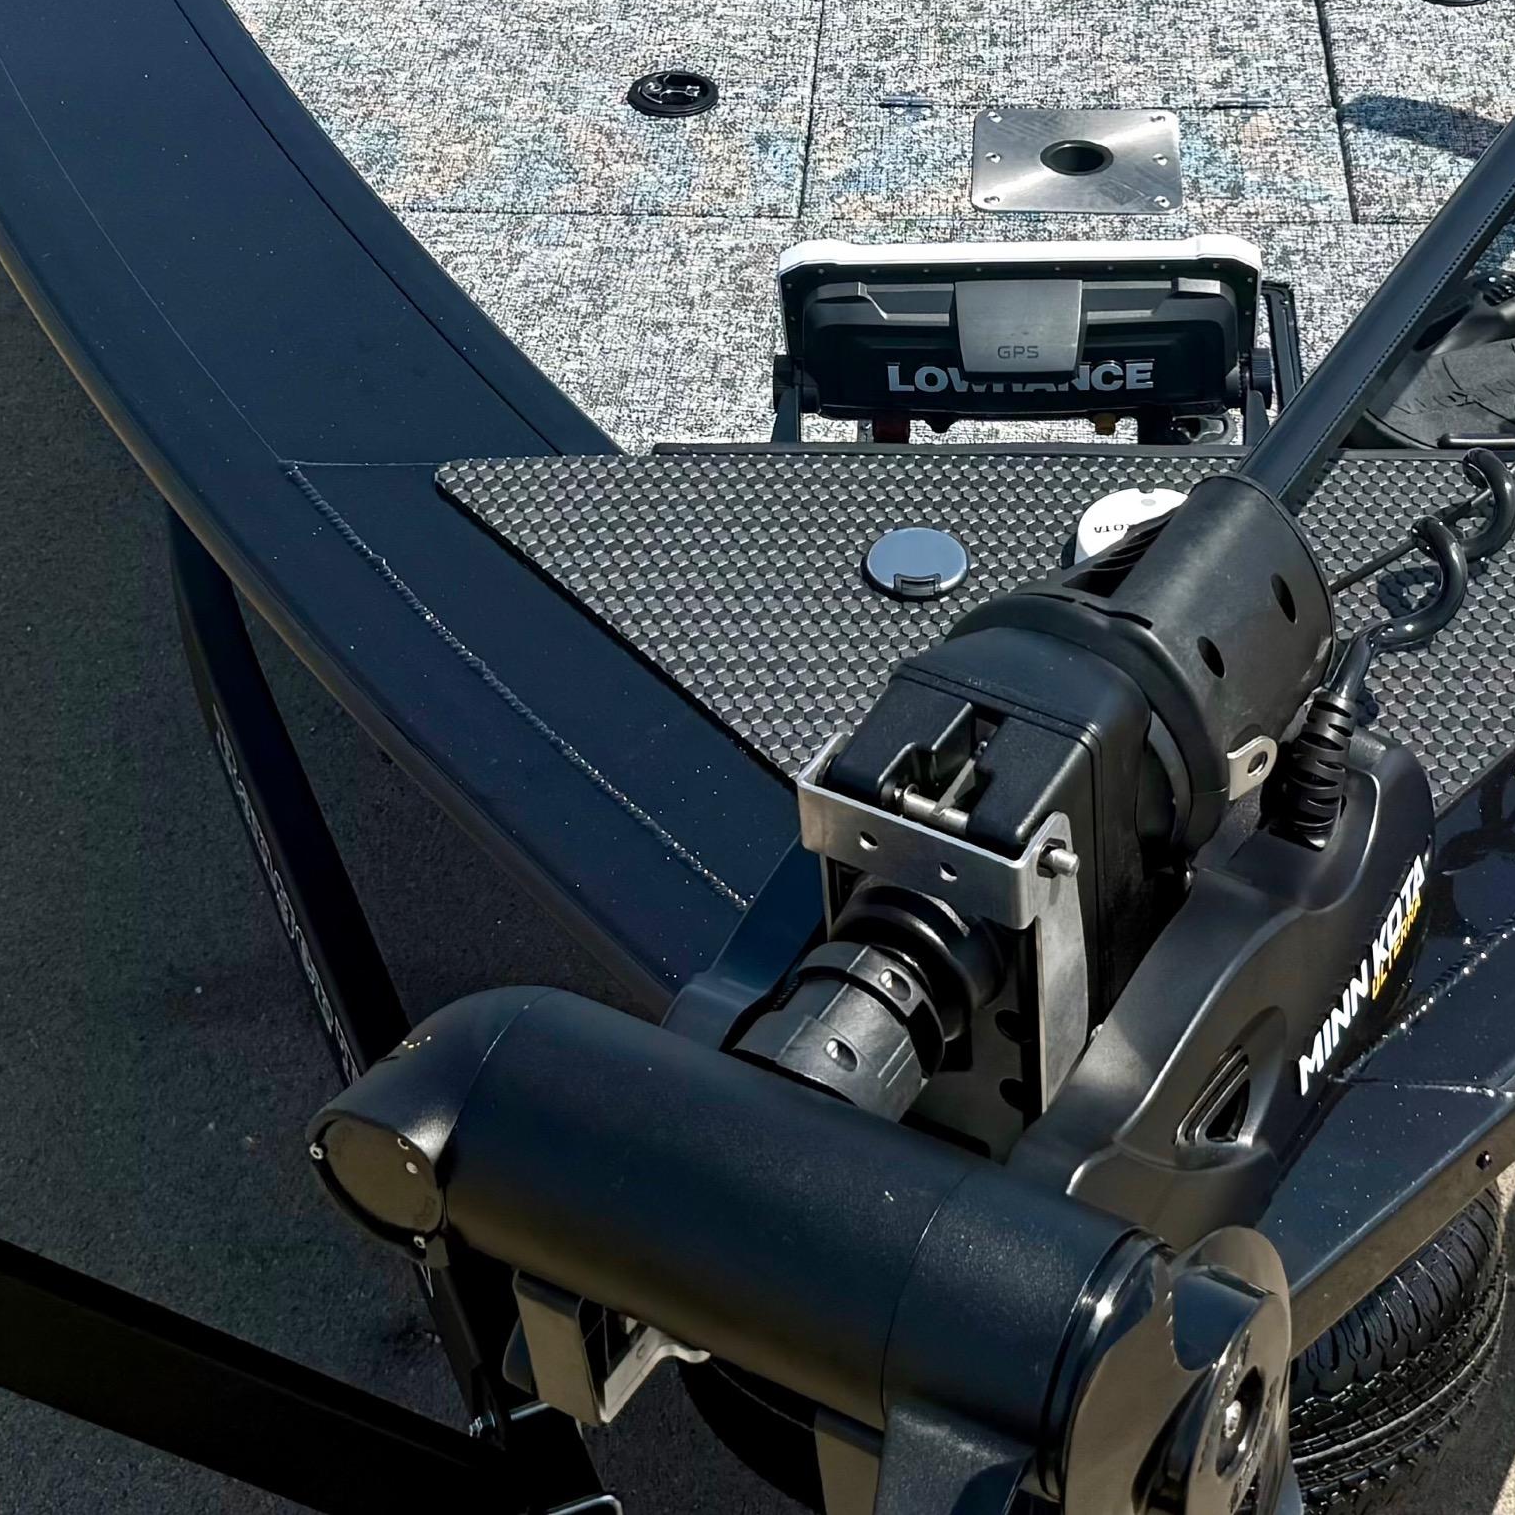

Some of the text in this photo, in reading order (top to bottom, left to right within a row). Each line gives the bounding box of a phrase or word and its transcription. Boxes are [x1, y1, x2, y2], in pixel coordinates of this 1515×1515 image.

[997, 345, 1039, 359] GPS
[1094, 523, 1130, 534] OTA
[1298, 854, 1425, 1096] MINN KOTA
